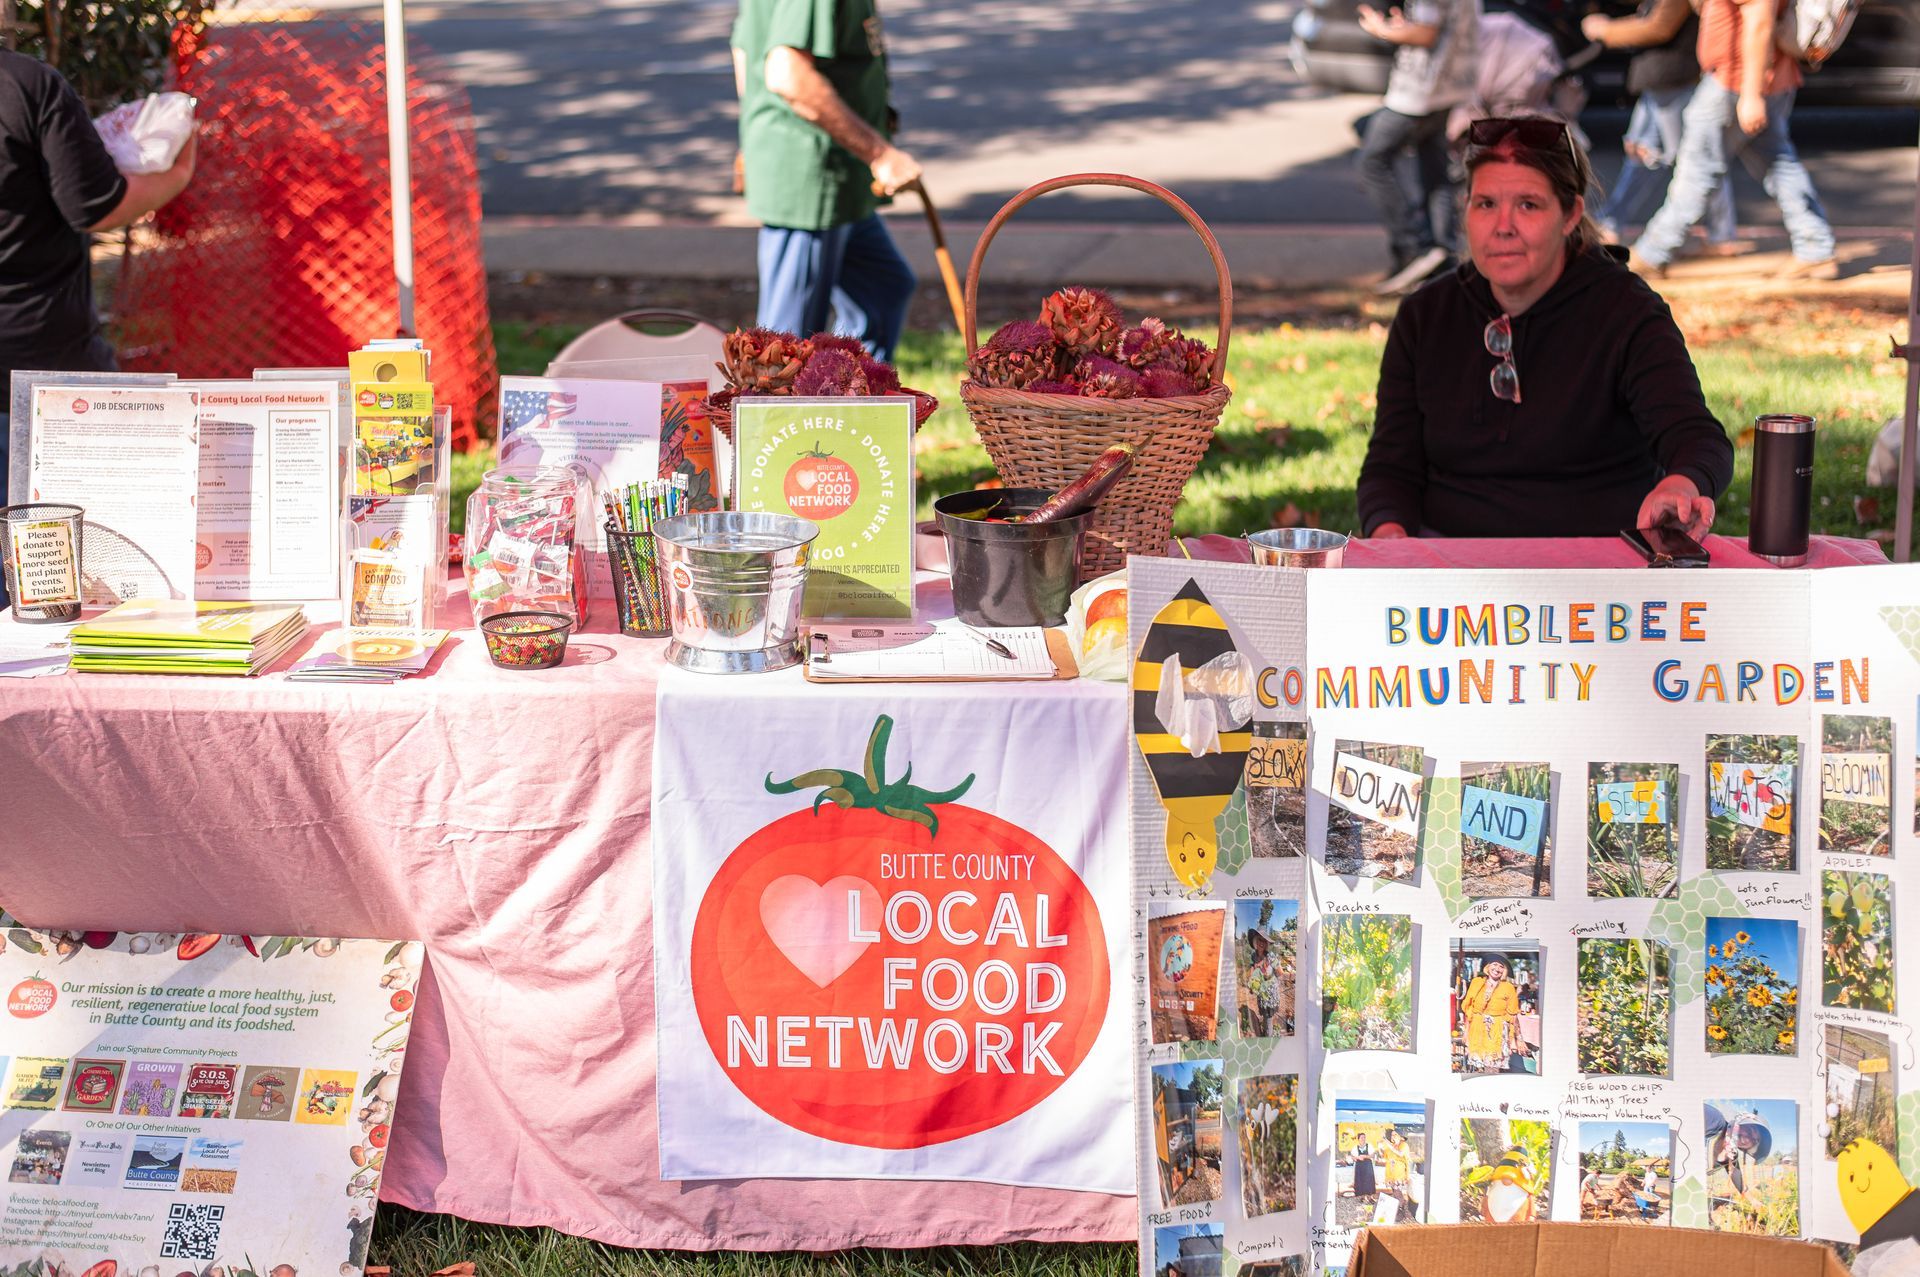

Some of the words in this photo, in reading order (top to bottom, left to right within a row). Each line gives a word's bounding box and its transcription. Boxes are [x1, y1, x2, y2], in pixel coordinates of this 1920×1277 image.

[208, 395, 238, 405] County
[240, 394, 262, 404] Local
[265, 394, 285, 403] Food
[288, 394, 325, 403] Network
[93, 402, 107, 410] JOB
[108, 402, 164, 411] DESCRIPTIONS
[803, 416, 844, 431] HERE
[752, 422, 799, 478] DONATE
[860, 434, 894, 498] DONATE
[810, 471, 851, 482] LOCAL
[818, 484, 851, 495] FOOD
[789, 495, 851, 506] NETWORK
[862, 504, 890, 542] HERE
[28, 531, 57, 539] Please
[23, 540, 54, 550] donate
[28, 550, 62, 559] support
[27, 569, 42, 577] and
[45, 568, 66, 578] plant
[844, 565, 850, 574] IS
[852, 564, 900, 574] APPRECIATED
[32, 578, 64, 586] events.
[365, 574, 407, 584] COMPOST
[31, 586, 66, 596] Thanks!
[1385, 601, 1707, 646] BUMBLEBEE
[1256, 658, 1598, 710] COMMUNITY
[1652, 657, 1870, 706] GARDEN
[1248, 746, 1303, 779] SLOW
[1340, 766, 1421, 822] DOWN
[1468, 800, 1528, 841] AND
[1608, 790, 1650, 816] SEE
[1824, 763, 1886, 797] BLOOMIN
[1824, 856, 1872, 868] APPLES
[880, 854, 946, 880] BUTTE
[952, 854, 1036, 882] COUNTY
[1236, 887, 1274, 897] Cabbage
[1738, 884, 1757, 893] Lots
[1326, 901, 1381, 912] Peaches
[1471, 903, 1489, 914] THE
[848, 890, 1068, 949] LOCAL
[1458, 916, 1492, 929] Garden
[1494, 900, 1522, 915] Faerie
[1481, 916, 1518, 934] Shelley
[1569, 920, 1615, 936] Tomatillo
[882, 957, 1067, 1016] FOOD
[62, 982, 85, 993] Our
[87, 983, 134, 995] mission
[137, 985, 146, 995] is
[151, 986, 164, 996] to
[166, 987, 204, 997] create
[208, 990, 215, 998] a
[219, 990, 251, 999] more
[255, 988, 305, 1004] healthy,
[308, 991, 336, 1004] just,
[9, 1003, 50, 1011] NETWORK
[71, 998, 124, 1010] resilient,
[127, 1000, 206, 1013] regenerative
[210, 1002, 239, 1014] local
[241, 1003, 271, 1017] food
[274, 1006, 319, 1018] system
[90, 1012, 101, 1023] in
[105, 1013, 138, 1025] Butte
[142, 1014, 186, 1030] County
[189, 1016, 213, 1028] and
[217, 1017, 231, 1028] its
[234, 1018, 296, 1032] foodshed.
[726, 1014, 1065, 1076] NETWORK
[96, 1044, 111, 1052] Join
[127, 1045, 161, 1055] Signature
[163, 1047, 207, 1056] Community
[208, 1048, 238, 1058] Projects
[137, 1064, 176, 1072] GROWN
[199, 1070, 227, 1079] S.O.S.
[1568, 1082, 1594, 1091] FREE
[1599, 1083, 1628, 1091] WOOD
[1631, 1084, 1663, 1093] CHIPS
[1566, 1095, 1579, 1105] All
[1584, 1096, 1616, 1109] Things
[1620, 1095, 1648, 1104] Trees
[1458, 1104, 1492, 1113] Hidden
[1615, 1109, 1662, 1120] Volunteers
[97, 1121, 113, 1129] One
[114, 1121, 125, 1129] Of
[143, 1123, 164, 1131] Other
[166, 1124, 201, 1133] Initiatives
[128, 1170, 148, 1179] Butte
[151, 1171, 178, 1182] County
[9, 1196, 40, 1205] Website:
[43, 1198, 99, 1209] bclocalfood.org
[6, 1207, 43, 1216] Facebook:
[1148, 1212, 1172, 1225] FREE
[1180, 1209, 1204, 1222] FOOD
[4, 1218, 41, 1226] Instagram:
[1238, 1236, 1276, 1255] Compost
